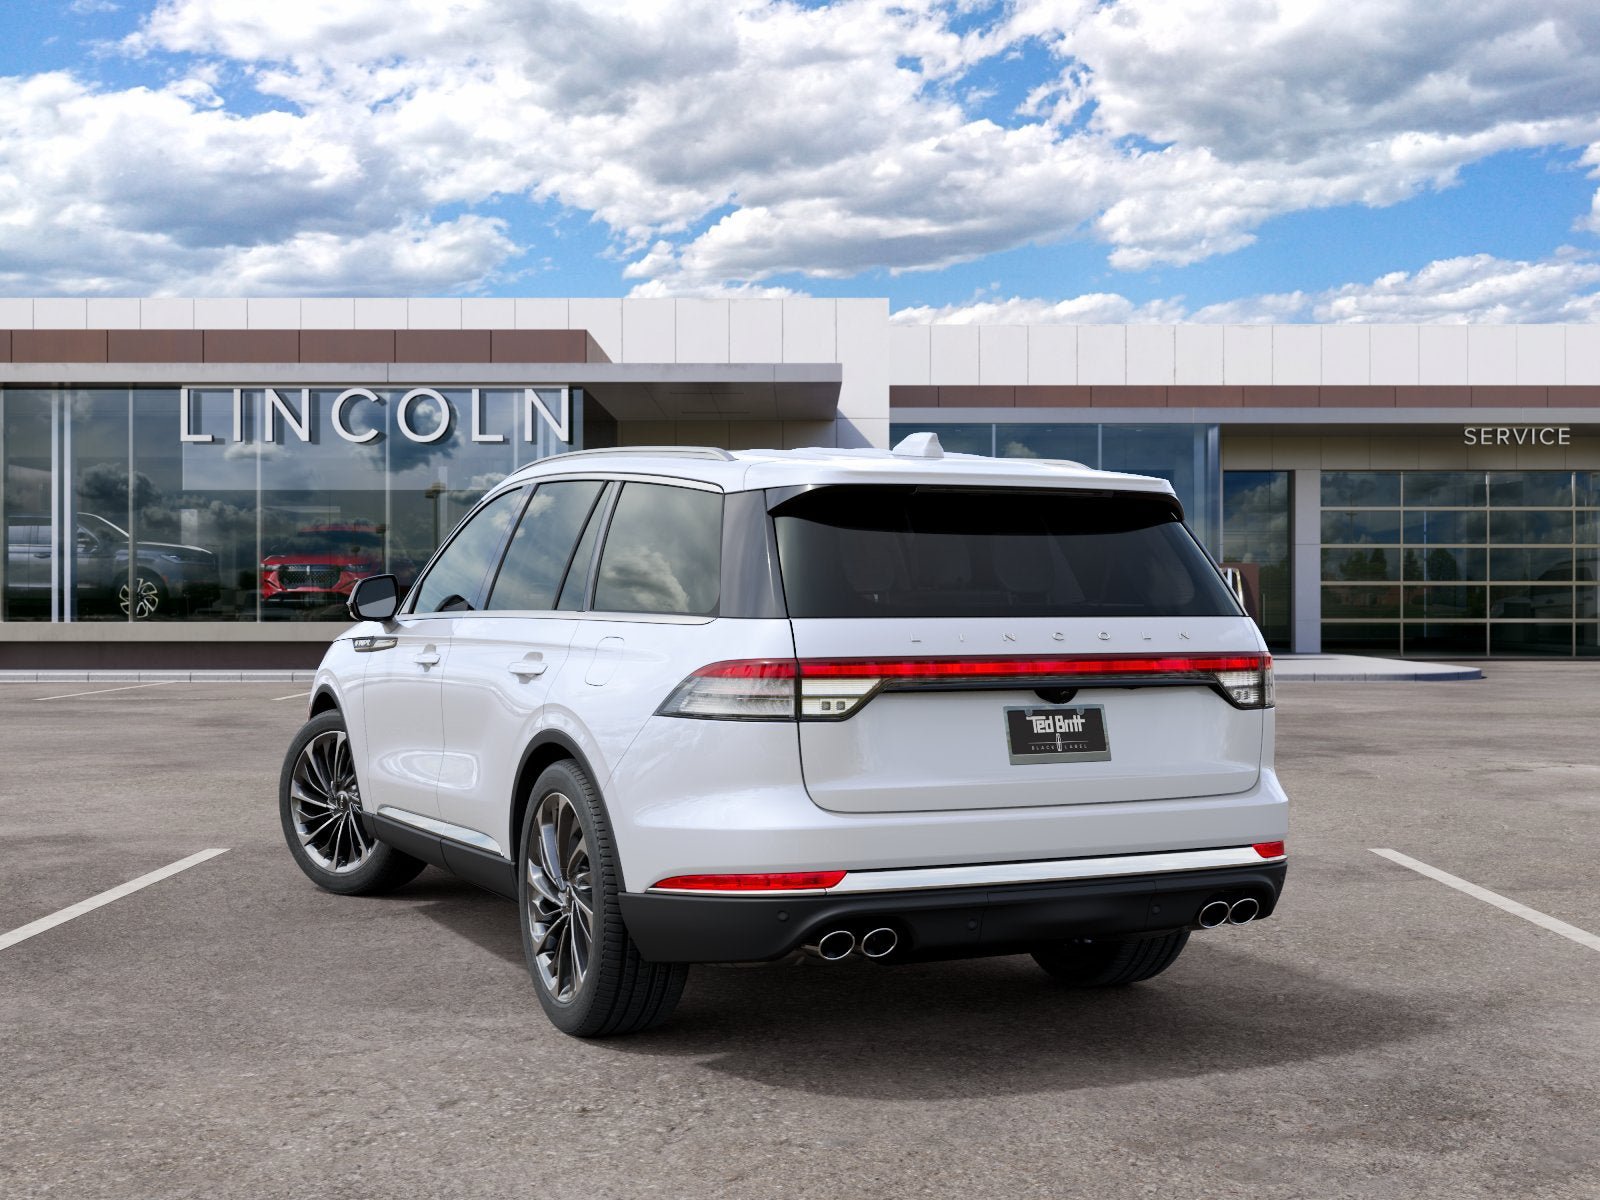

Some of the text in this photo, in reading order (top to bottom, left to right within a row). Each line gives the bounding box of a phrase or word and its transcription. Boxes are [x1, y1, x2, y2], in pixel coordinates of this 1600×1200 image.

[180, 388, 570, 443] LINCOLN
[1464, 427, 1570, 445] SERVICE
[910, 631, 1190, 642] LINCOLN
[1026, 715, 1085, 733] Ted Britt
